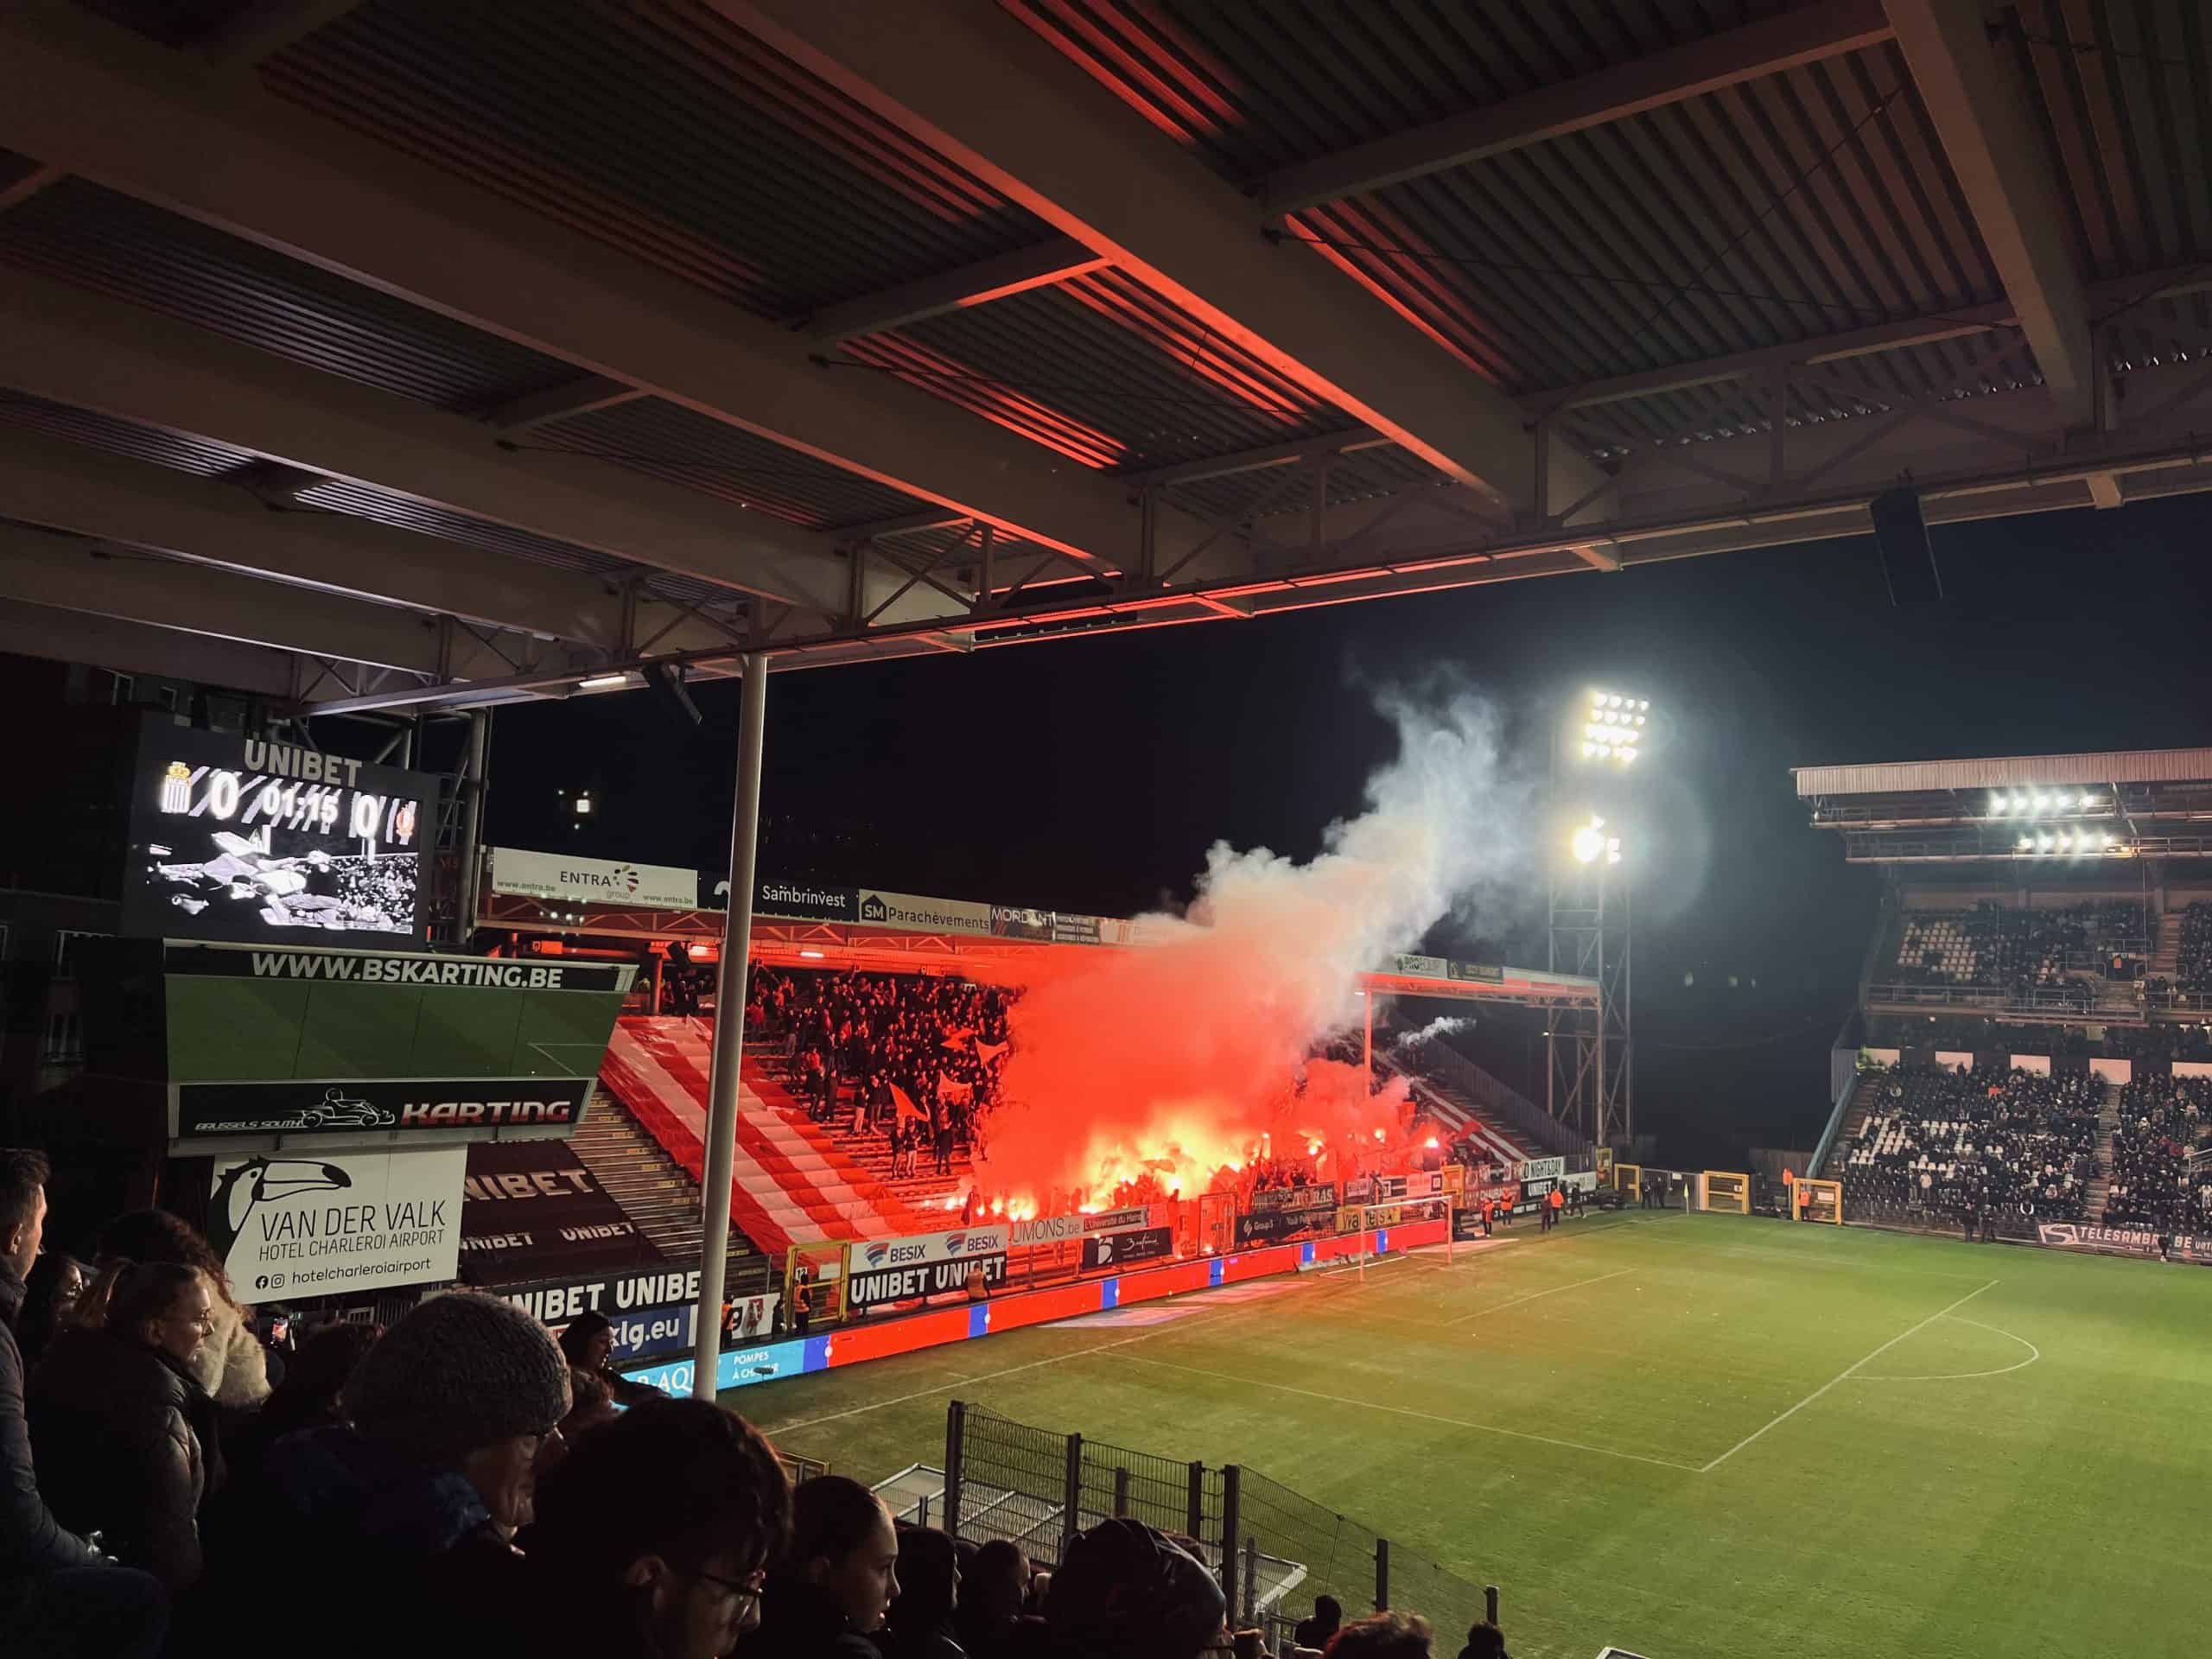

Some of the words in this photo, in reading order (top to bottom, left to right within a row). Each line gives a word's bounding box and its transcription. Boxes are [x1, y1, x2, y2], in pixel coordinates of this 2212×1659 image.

[245, 739, 362, 788] UNIBET
[210, 771, 239, 821] 0
[261, 784, 339, 823] 01:15
[353, 794, 379, 838] 0
[497, 879, 556, 893] www.entra.be
[560, 870, 612, 887] ENTRA
[607, 890, 631, 900] group
[643, 893, 693, 905] www.entra.be
[762, 884, 846, 907] Sambrinvest
[864, 904, 885, 919] SM
[888, 907, 990, 930] Parachèvements
[250, 952, 564, 988] WWW.BSKARTING.BE
[194, 1121, 258, 1131] BRUSSELS
[261, 1119, 304, 1128] SOUTH
[400, 1101, 570, 1127] KARTING
[463, 1169, 594, 1202] NIBET
[261, 1210, 317, 1242] VAN
[325, 1205, 376, 1236] DER
[385, 1199, 447, 1230] VALK
[561, 1222, 634, 1242] UNIBET
[1011, 1217, 1065, 1244] UMONS
[259, 1243, 304, 1262] HOTEL
[308, 1233, 386, 1257] CHARLEROI
[389, 1229, 445, 1249] AIRPORT
[890, 1244, 926, 1263] BESIX
[967, 1234, 999, 1252] BESIX
[291, 1257, 432, 1285] hotelcharleroiairport
[512, 1283, 605, 1322] NIBET
[616, 1271, 701, 1309] UNIBE
[850, 1268, 930, 1305] UNIBET
[734, 1351, 769, 1365] POMPES
